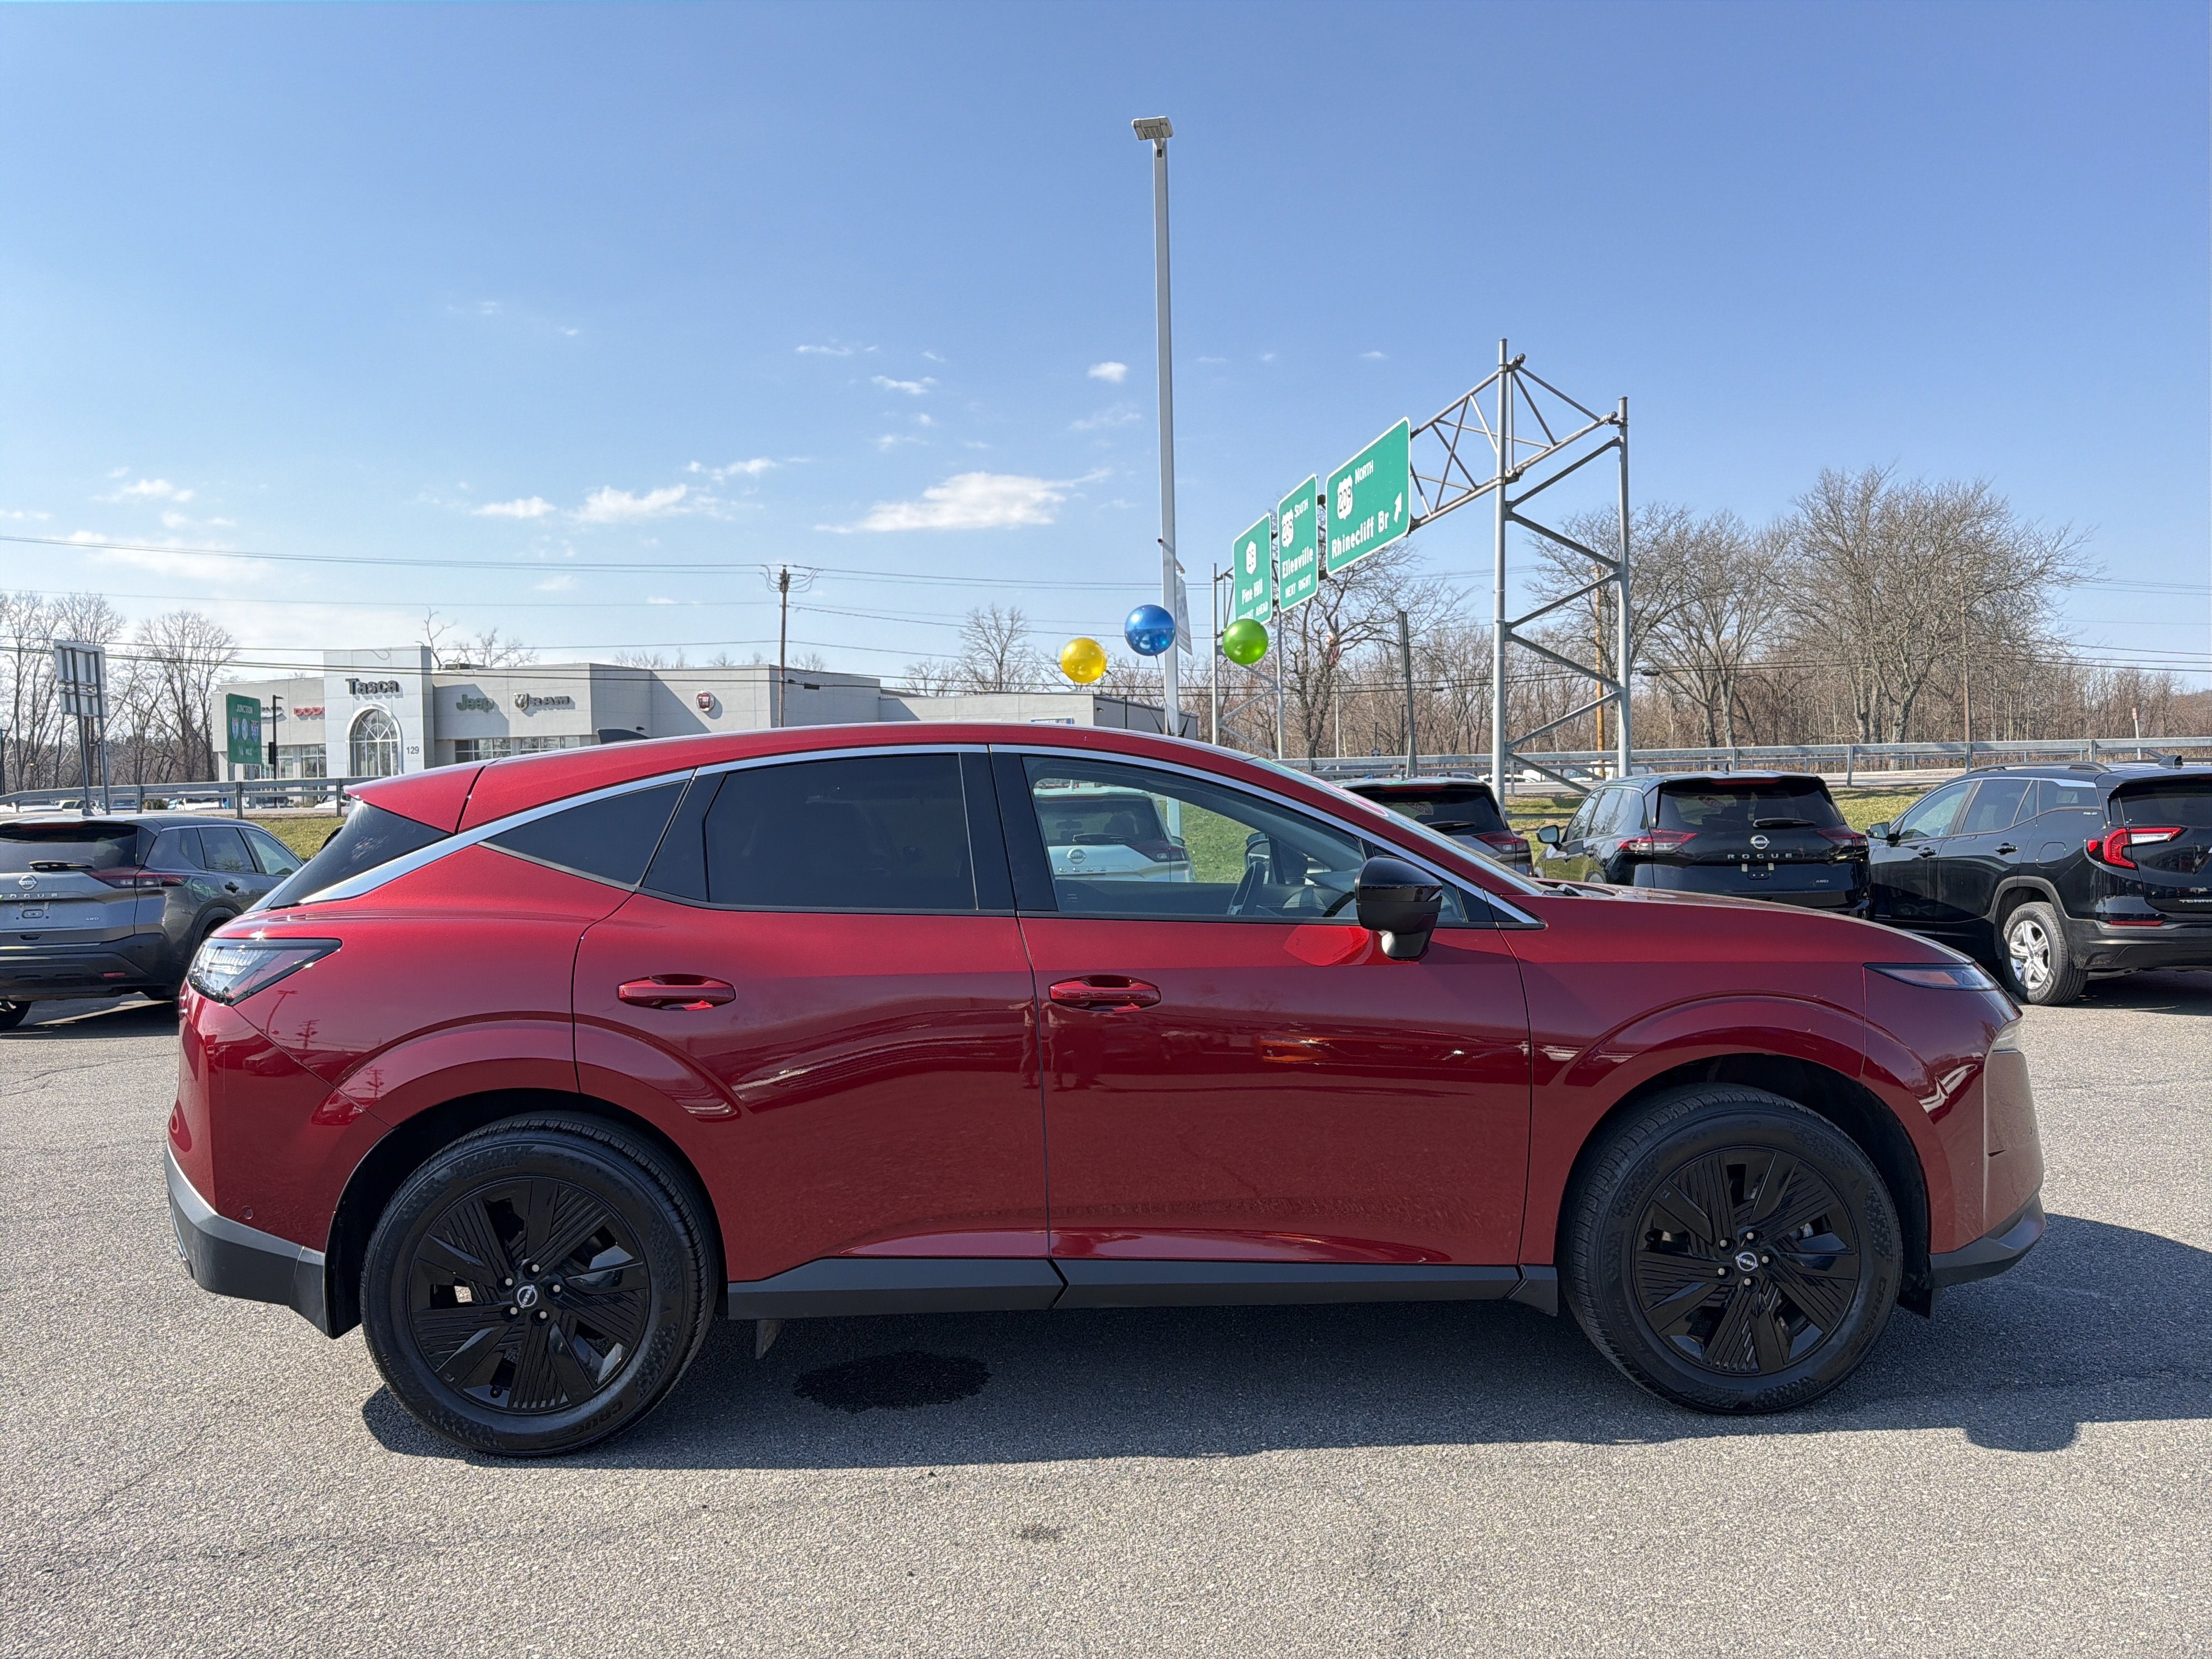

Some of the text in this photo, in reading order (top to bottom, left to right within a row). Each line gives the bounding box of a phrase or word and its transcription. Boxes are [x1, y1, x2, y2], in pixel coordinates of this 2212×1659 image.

[1355, 460, 1374, 484] NORTH
[1294, 498, 1308, 518] SOUTH
[1339, 486, 1352, 513] 209
[1331, 510, 1389, 559] Rhinecliff Br
[1282, 546, 1313, 579] Ellenville
[1242, 577, 1263, 605] Pine Hill
[1285, 574, 1311, 598] NEXT RIGHT
[345, 678, 399, 695] Tasca
[236, 704, 253, 714] JUNCTION
[456, 694, 493, 713] Jeep
[530, 696, 569, 706] RAM
[406, 746, 420, 755] 129
